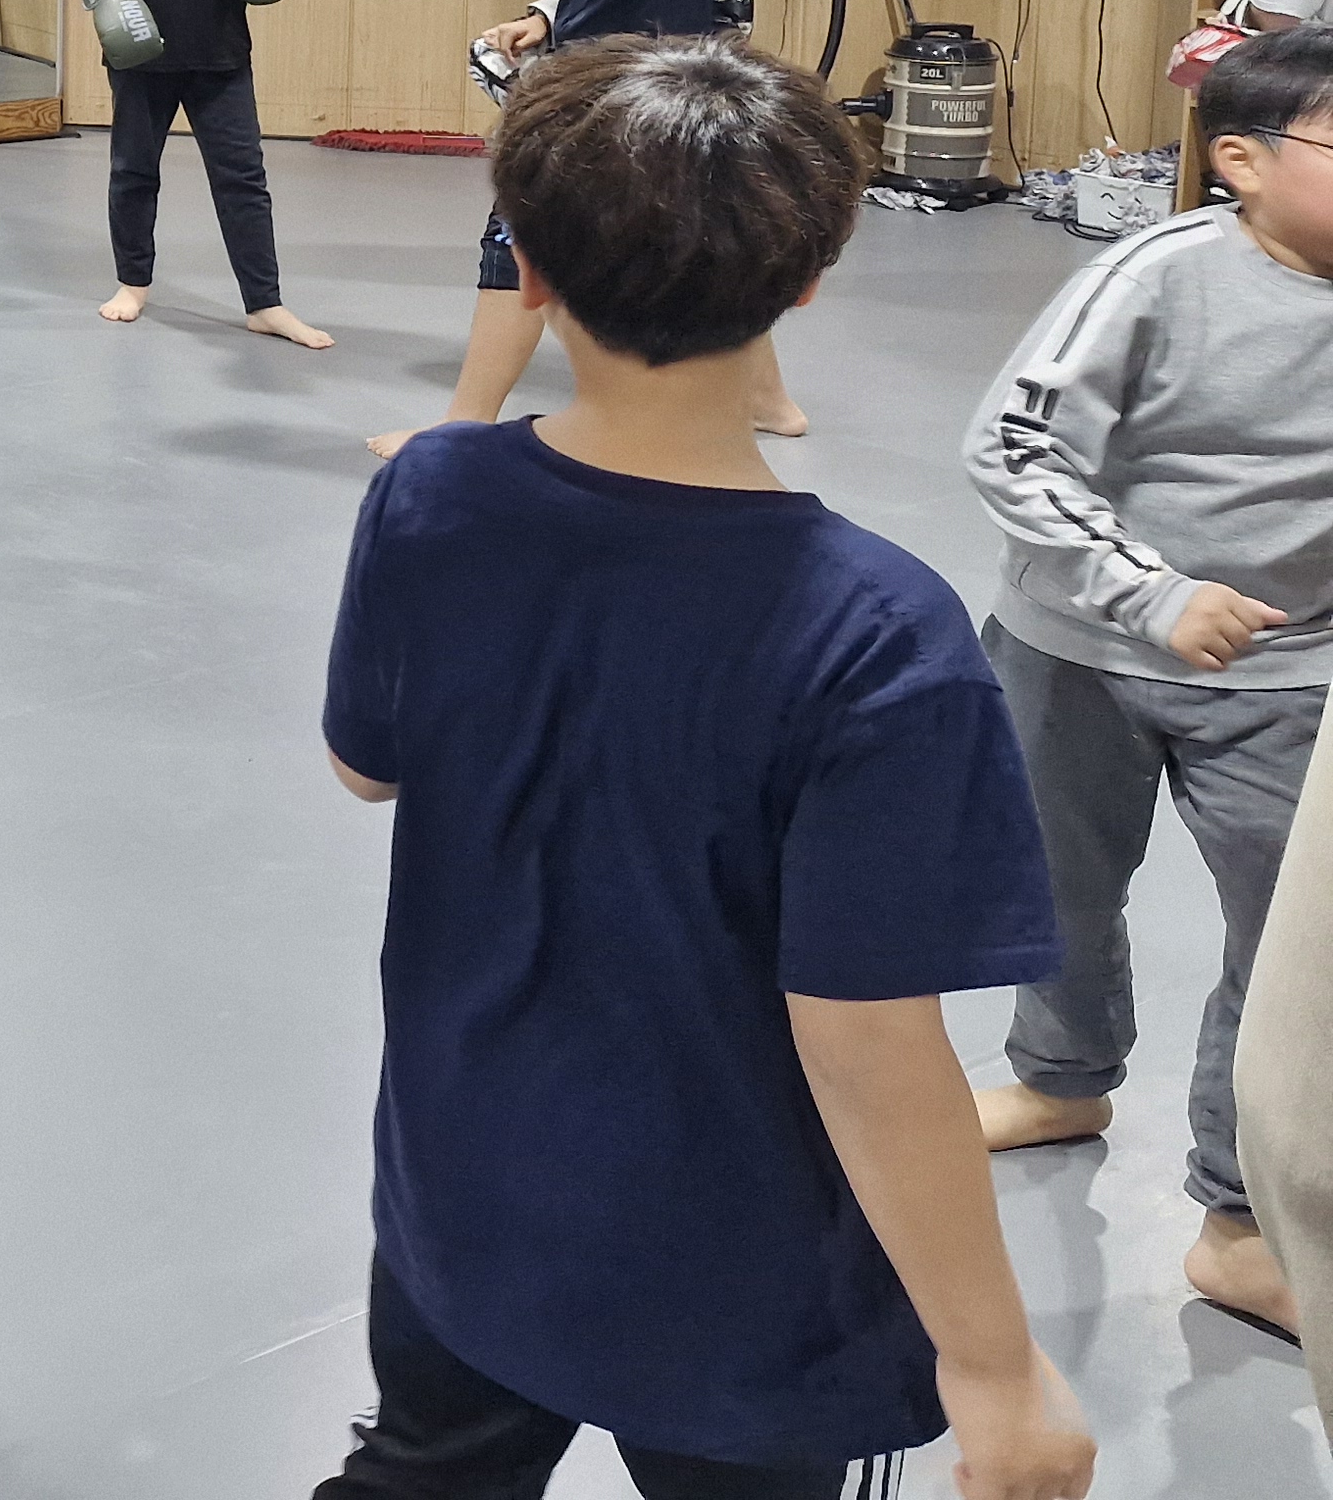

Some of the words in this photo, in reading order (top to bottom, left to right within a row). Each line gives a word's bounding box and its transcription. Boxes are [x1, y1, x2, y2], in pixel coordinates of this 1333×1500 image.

[921, 67, 944, 78] 20L
[943, 111, 979, 122] TURBO
[1000, 376, 1060, 475] FILA
